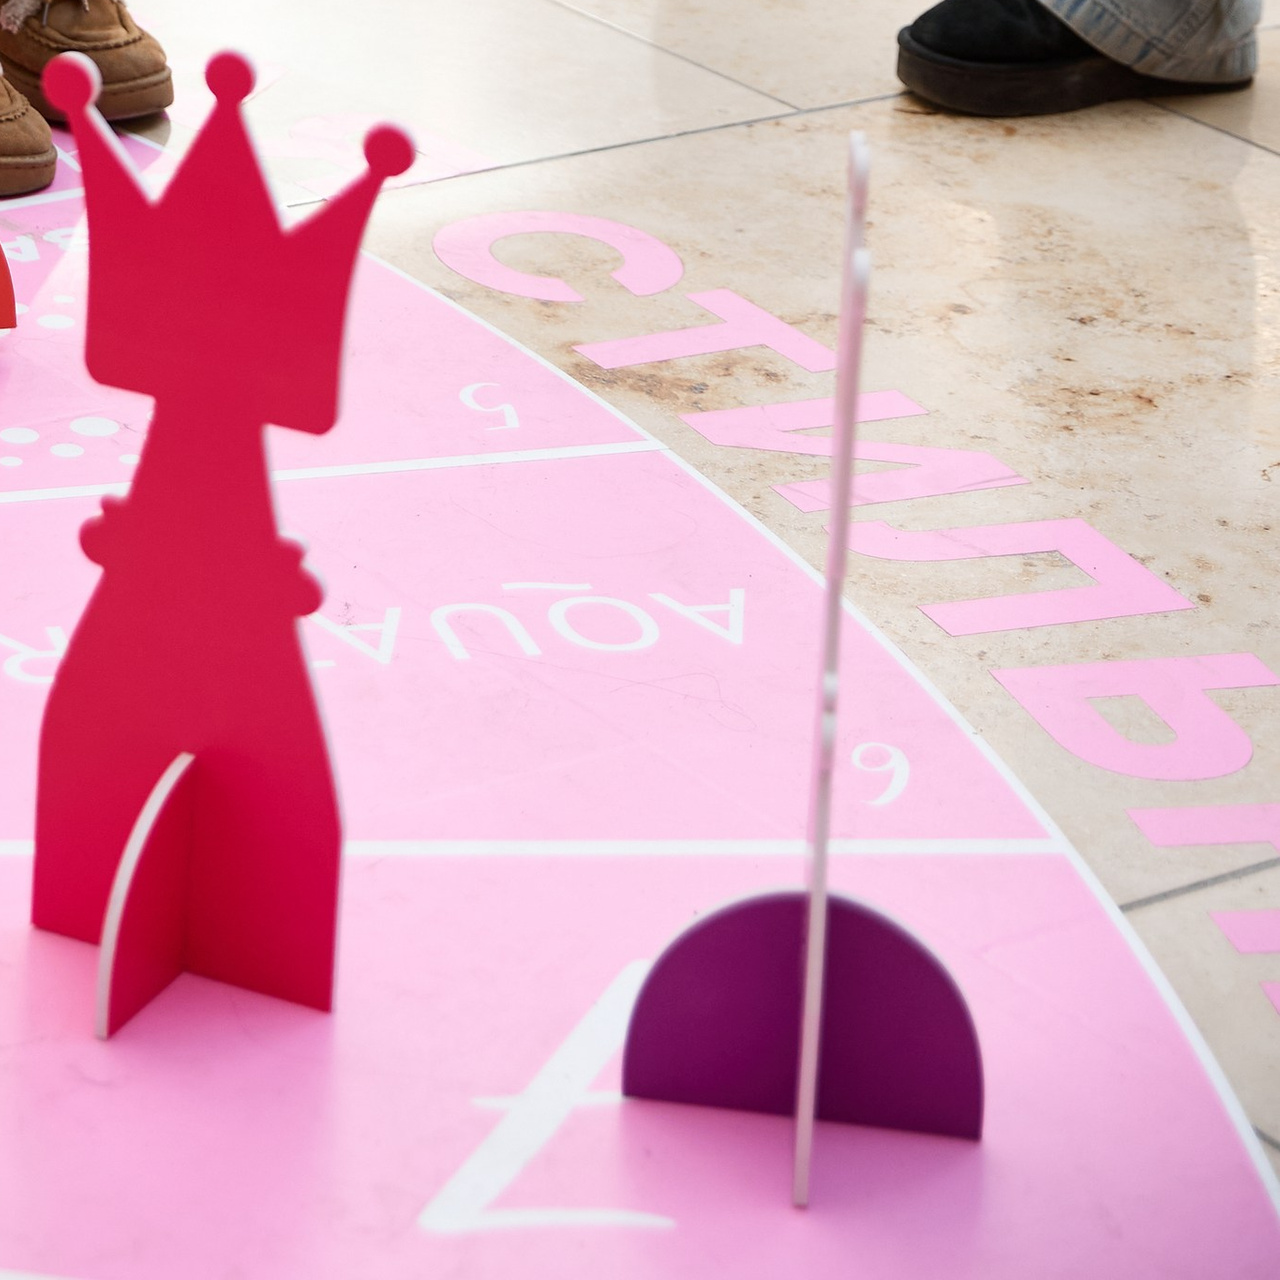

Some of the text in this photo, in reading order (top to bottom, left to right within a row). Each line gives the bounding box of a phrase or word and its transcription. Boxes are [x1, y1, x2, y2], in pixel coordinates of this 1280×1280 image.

[458, 382, 521, 430] 5
[851, 741, 910, 806] 6
[418, 957, 676, 1231] 7
